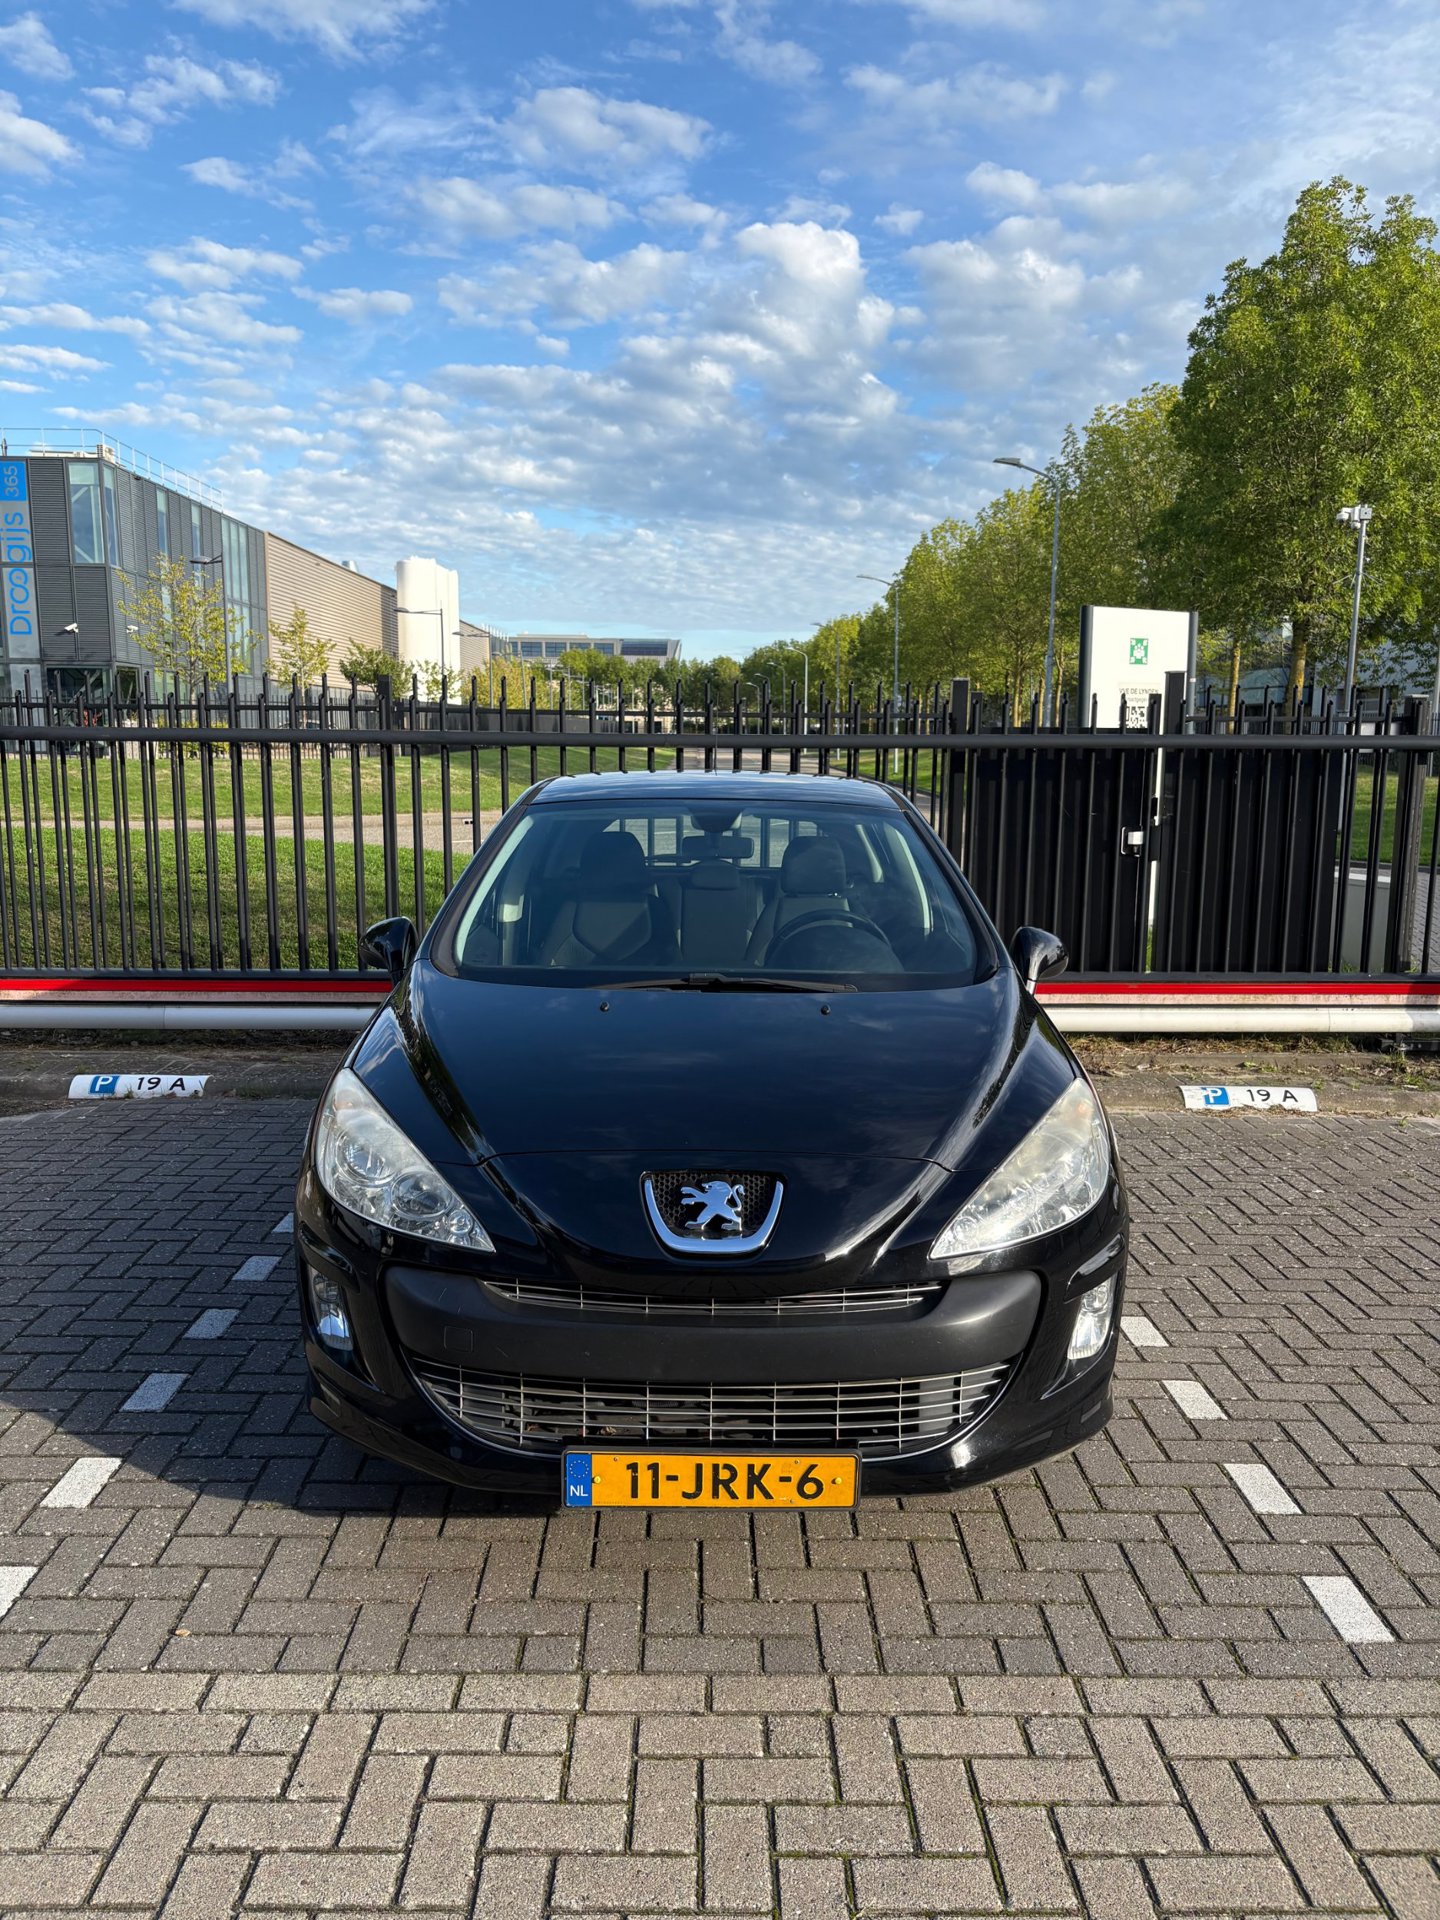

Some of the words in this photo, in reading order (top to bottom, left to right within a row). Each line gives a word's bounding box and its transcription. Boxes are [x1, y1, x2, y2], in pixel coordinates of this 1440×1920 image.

[3, 465, 19, 497] 365
[95, 1076, 113, 1092] P
[137, 1077, 161, 1090] 19
[169, 1077, 186, 1091] A
[1204, 1087, 1222, 1103] P
[1246, 1089, 1271, 1102] 19
[1282, 1090, 1298, 1102] A
[626, 1462, 824, 1501] 11-JRK-6
[570, 1485, 588, 1497] NL
